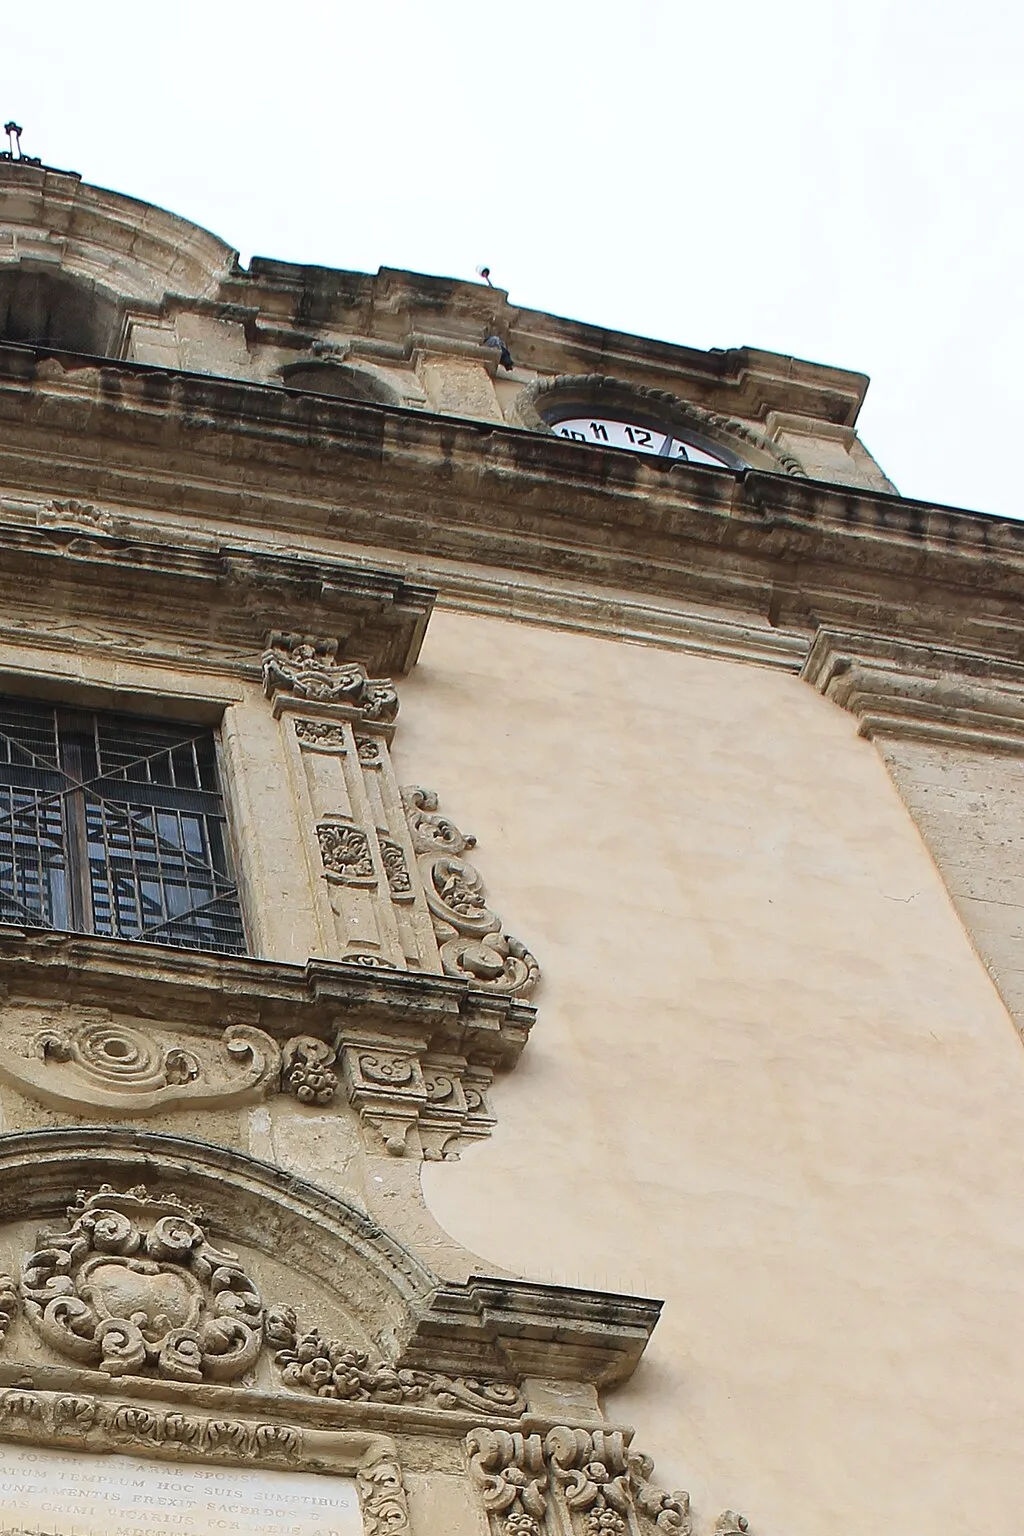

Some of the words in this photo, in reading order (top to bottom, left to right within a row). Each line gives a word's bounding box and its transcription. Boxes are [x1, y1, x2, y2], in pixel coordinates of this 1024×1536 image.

[590, 422, 609, 441] 11
[624, 427, 654, 448] 12
[157, 1481, 194, 1493] HOC
[204, 1487, 243, 1498] SUIS
[132, 1495, 196, 1508] EREXIT
[207, 1502, 297, 1518] SACERDOS
[108, 1508, 194, 1525] VICARIUS
